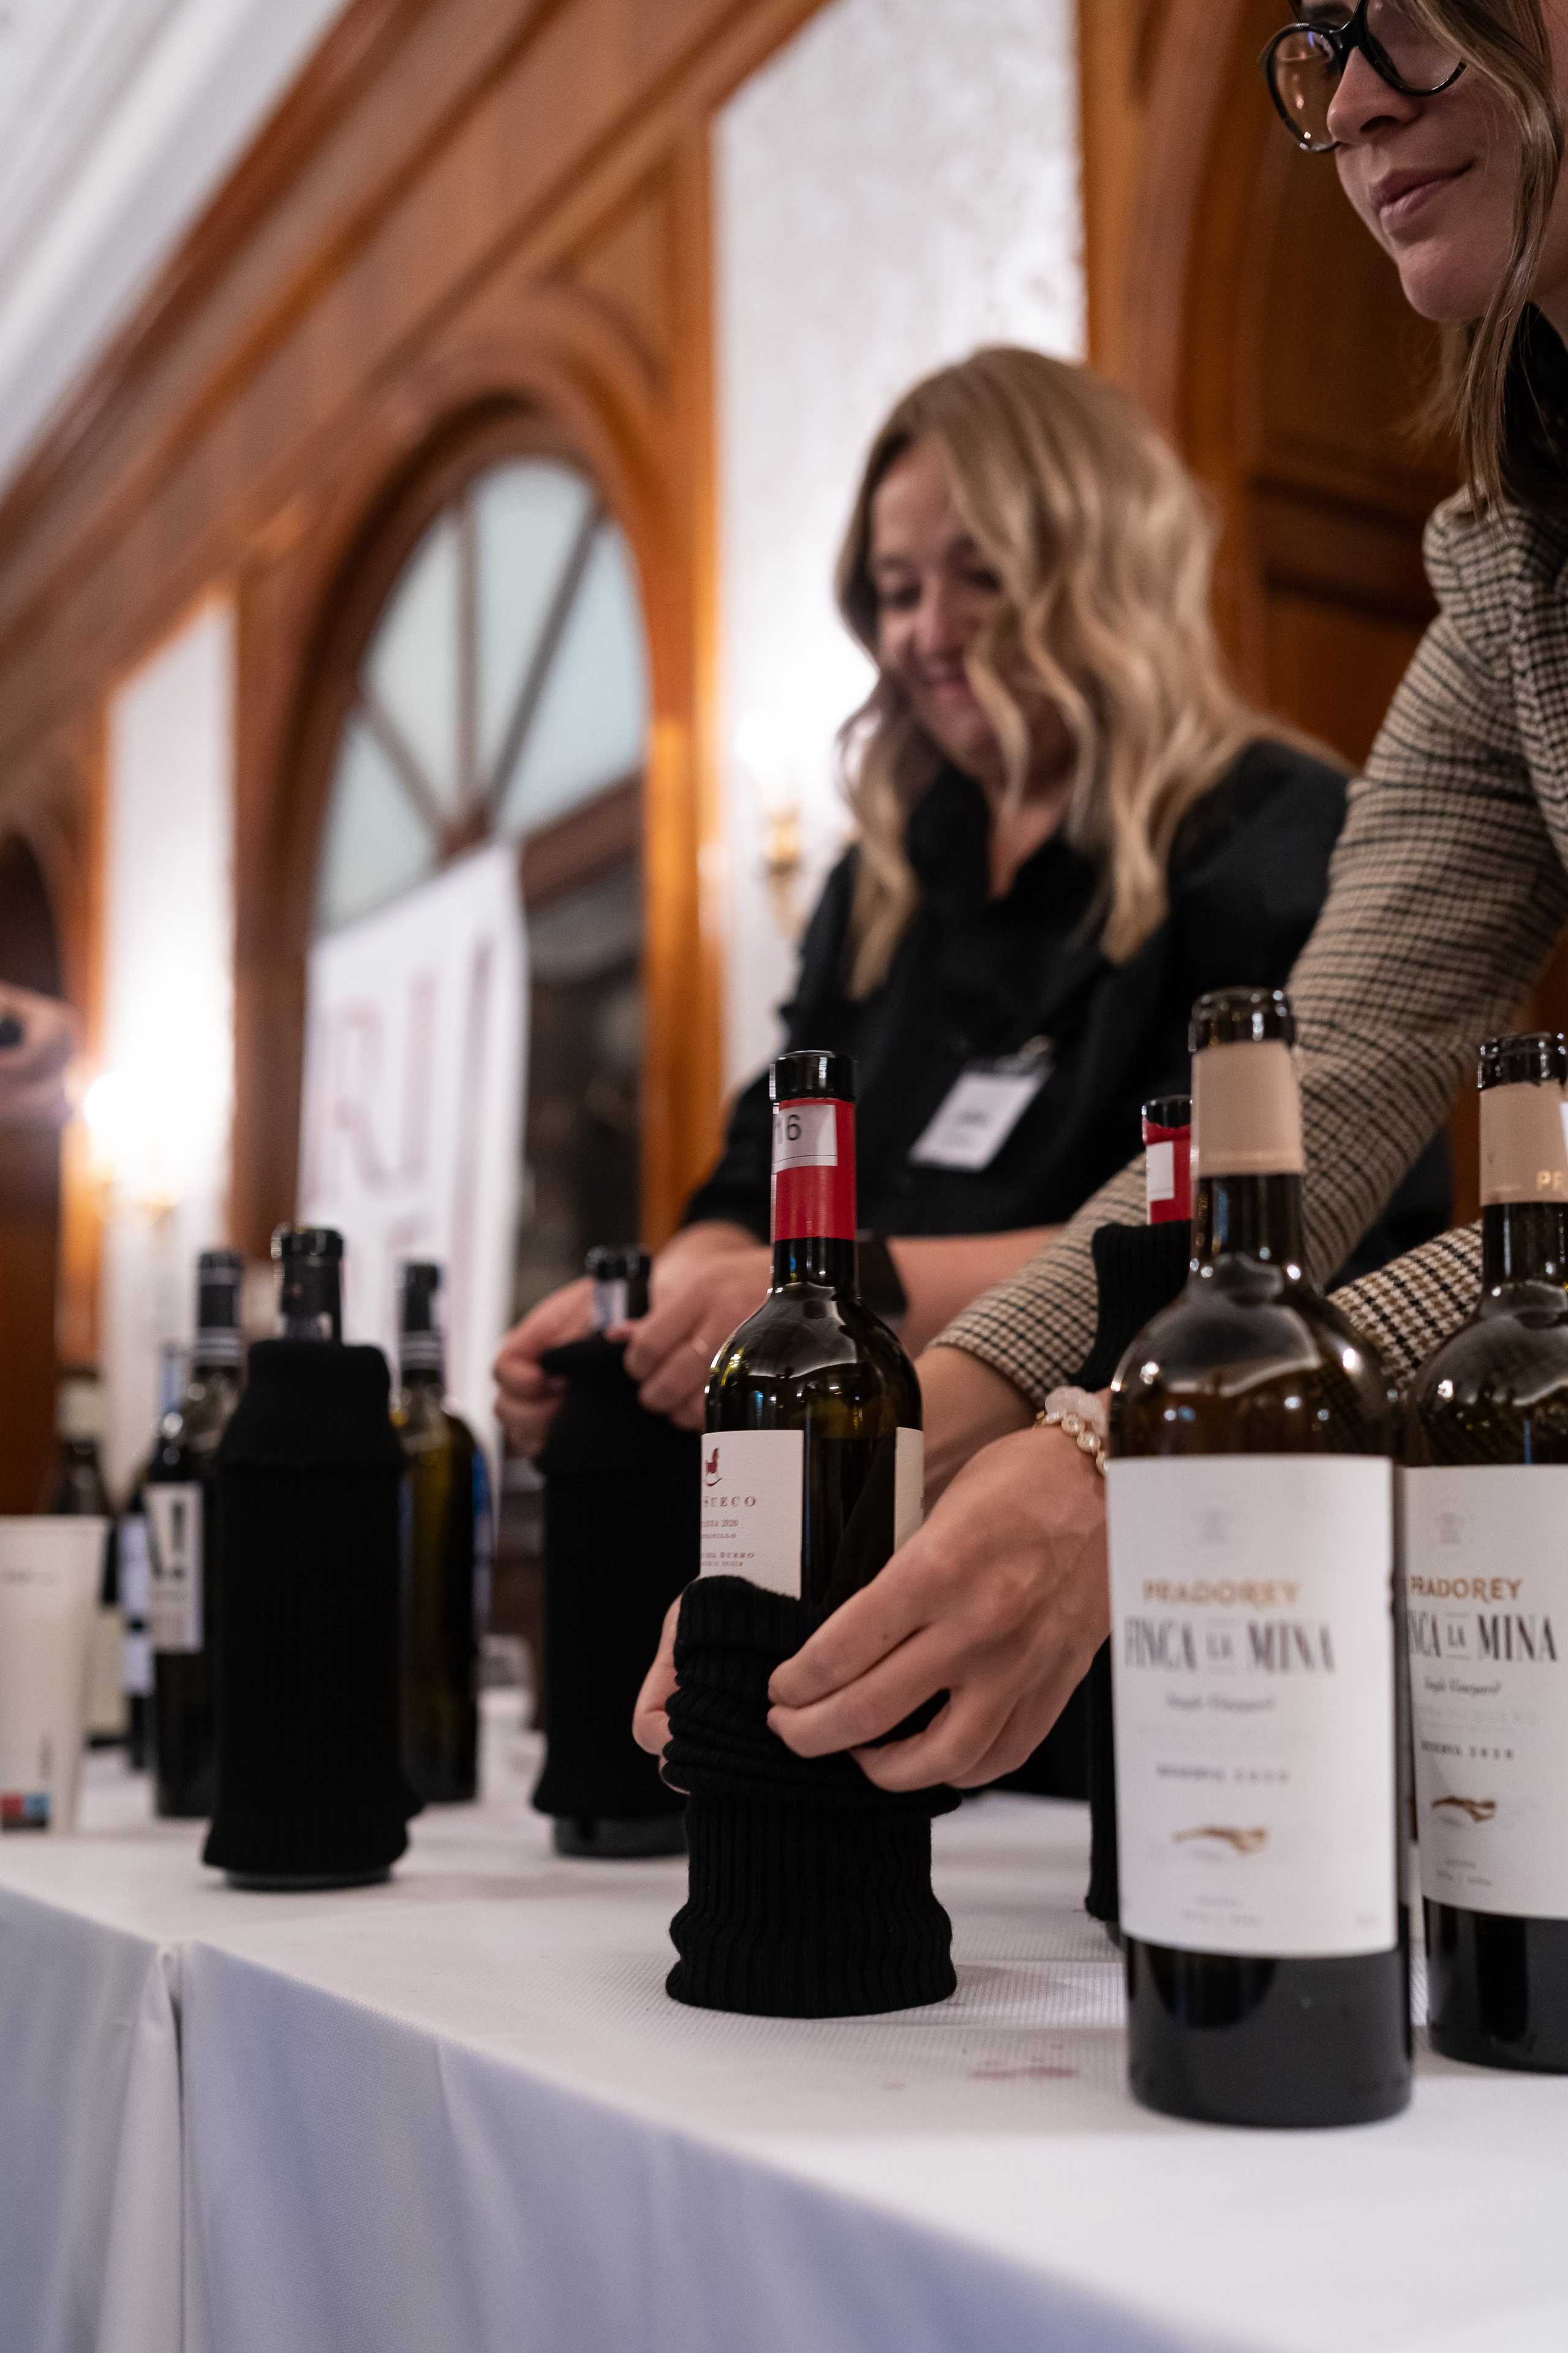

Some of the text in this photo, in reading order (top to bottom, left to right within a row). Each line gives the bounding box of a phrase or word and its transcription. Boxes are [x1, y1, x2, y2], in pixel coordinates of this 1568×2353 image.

[1246, 1619, 1336, 1675] MINA
[1447, 1623, 1466, 1647] LA
[1477, 1613, 1558, 1663] MINA
